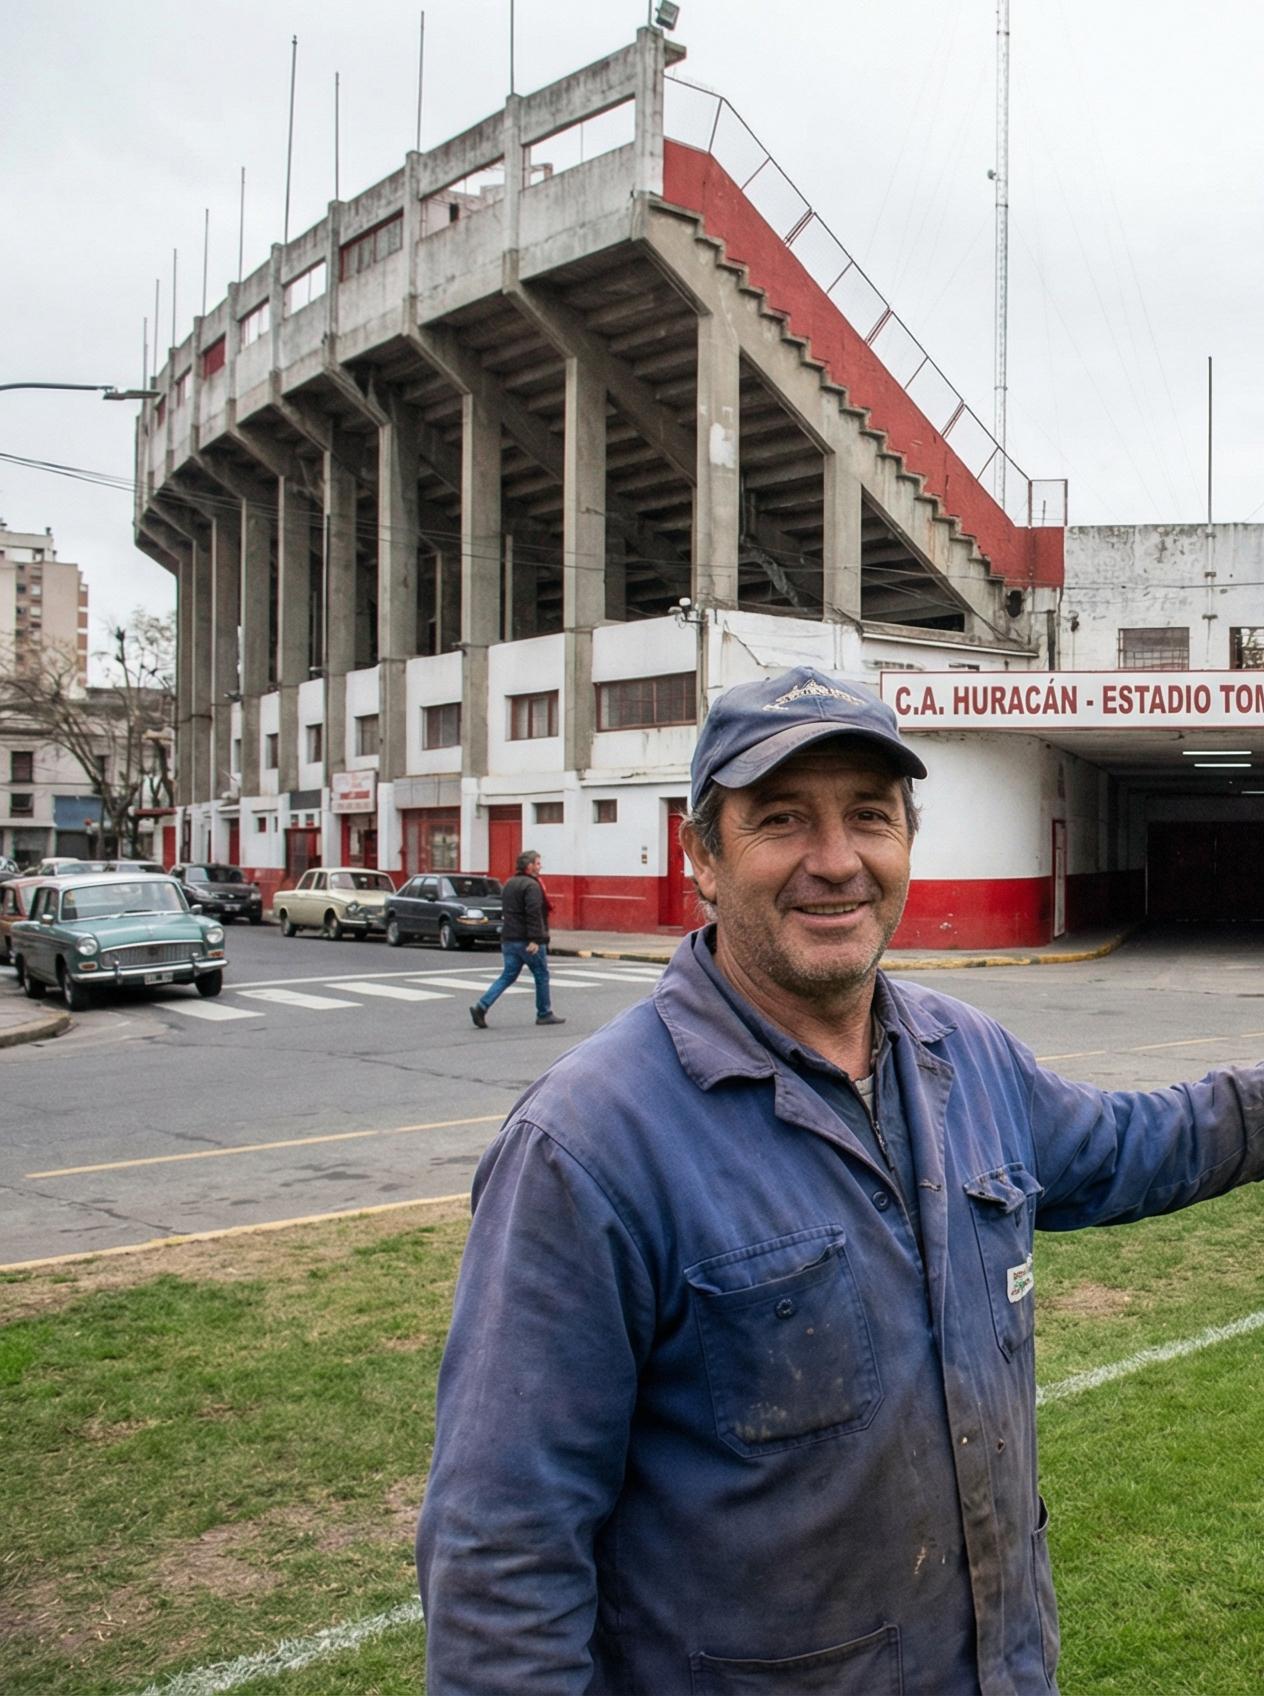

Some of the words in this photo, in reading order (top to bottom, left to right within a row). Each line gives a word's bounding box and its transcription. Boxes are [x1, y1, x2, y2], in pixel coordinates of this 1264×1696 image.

[896, 687, 945, 715] C.A.
[953, 678, 1078, 715] HURACÁN
[1102, 685, 1212, 714] ESTADIO
